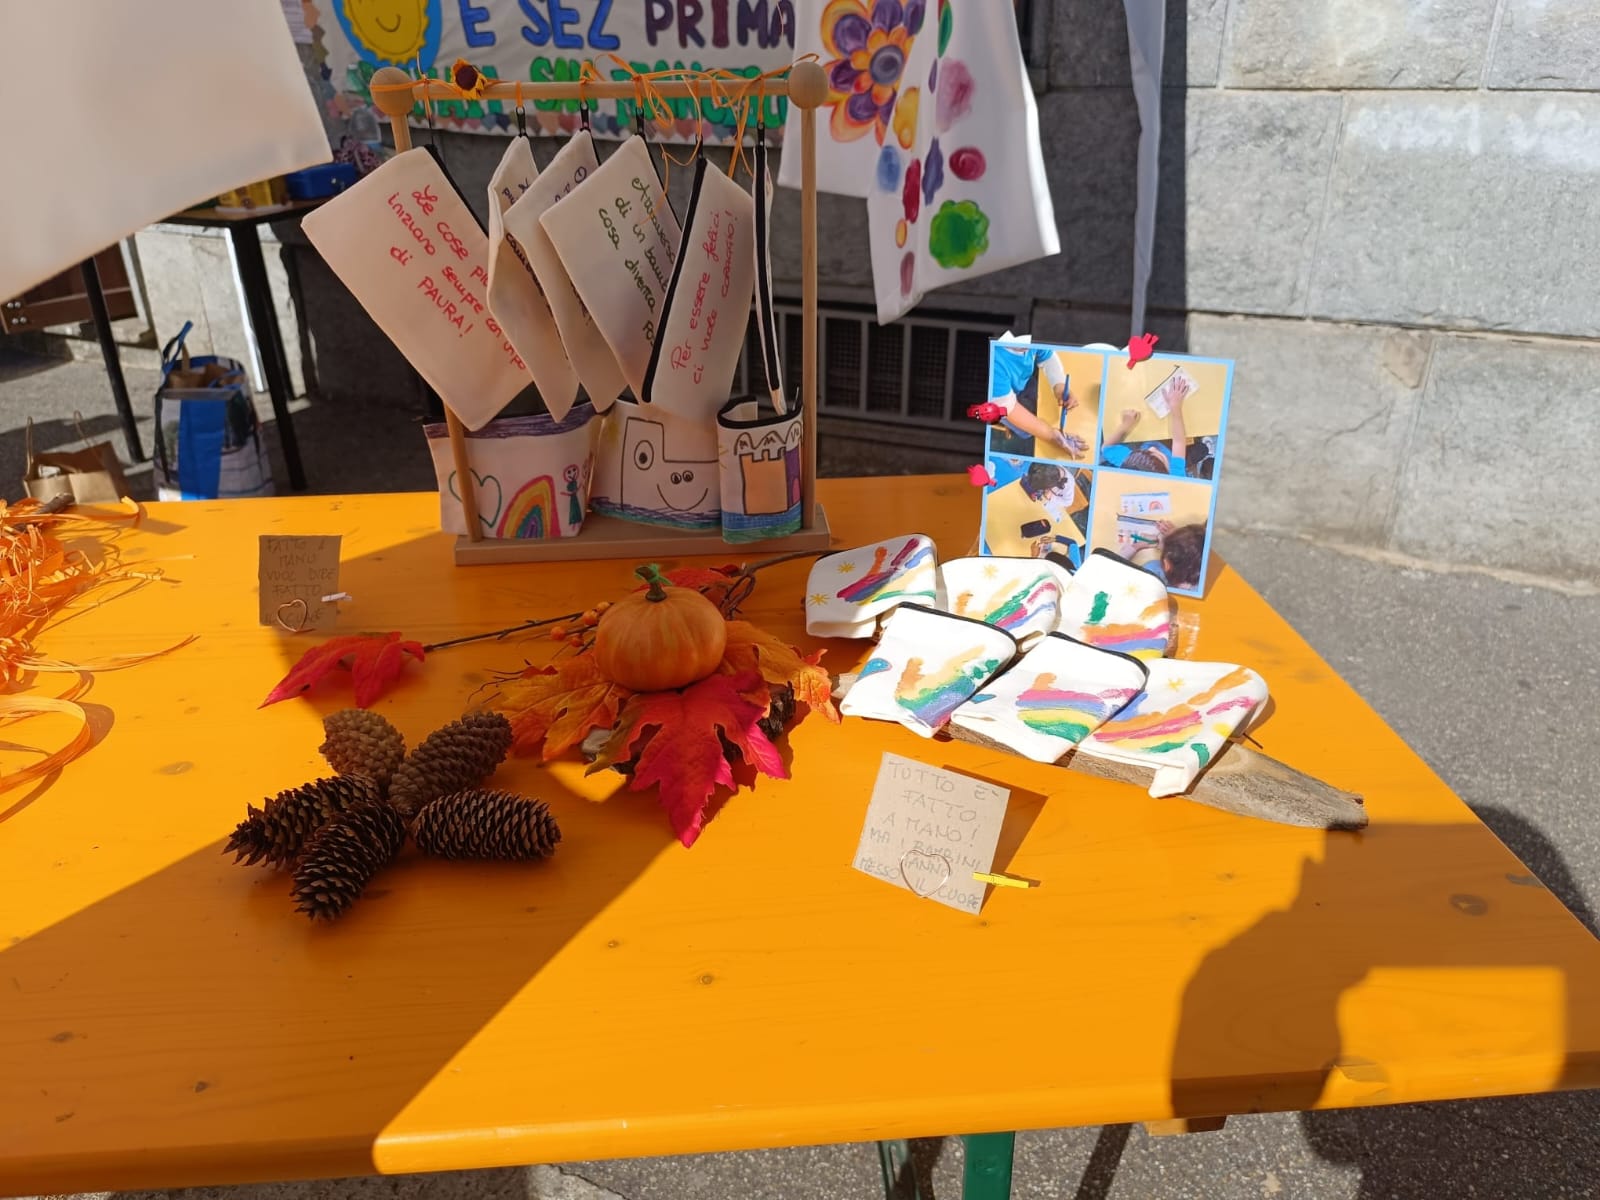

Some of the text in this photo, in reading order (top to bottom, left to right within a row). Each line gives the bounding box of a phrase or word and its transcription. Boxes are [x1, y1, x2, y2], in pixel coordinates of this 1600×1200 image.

[411, 184, 438, 216] Le
[436, 221, 469, 261] cose
[615, 197, 633, 218] di
[387, 191, 436, 256] iniziano
[441, 265, 484, 315] sempre
[389, 246, 414, 266] di
[598, 207, 620, 250] cosa
[624, 259, 656, 315] diventa
[670, 211, 720, 370] Per essere felici
[693, 363, 705, 385] ci
[701, 308, 718, 351] vuole
[888, 760, 955, 793] TUTTO
[882, 811, 895, 828] A
[902, 789, 977, 822] FATTO
[869, 827, 890, 845] MA
